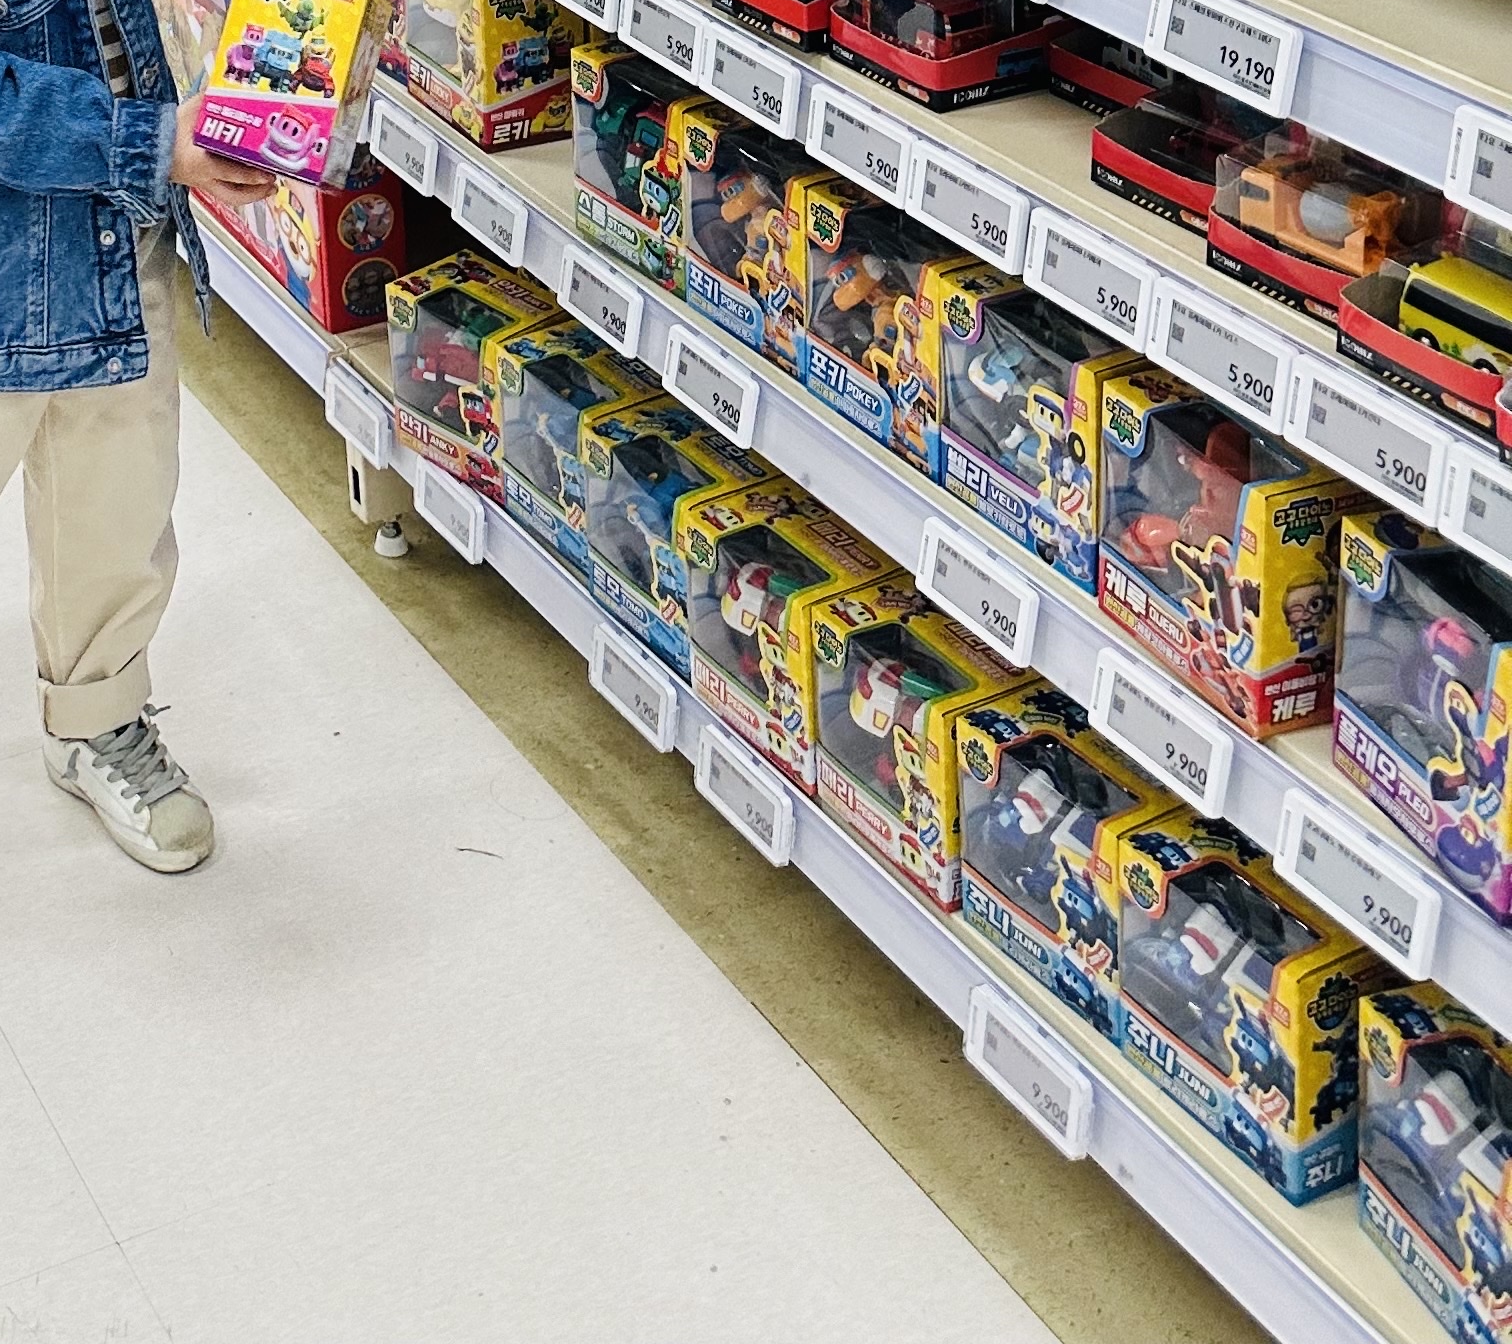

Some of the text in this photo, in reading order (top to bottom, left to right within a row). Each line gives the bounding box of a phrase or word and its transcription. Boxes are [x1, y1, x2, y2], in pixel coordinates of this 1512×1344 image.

[667, 34, 693, 62] 5,900
[1220, 45, 1275, 86] 19,190
[752, 84, 783, 115] 5,900
[492, 119, 530, 144] 로키
[865, 151, 899, 184] 5,900
[491, 218, 513, 246] 9,900
[606, 219, 636, 243] STORM
[971, 211, 1008, 248] 5,900
[690, 263, 721, 305] 포키
[601, 305, 627, 336] 9,900
[721, 291, 751, 321] POKEY
[1096, 285, 1138, 324] 5,900
[811, 346, 846, 394] 포키
[1228, 363, 1275, 405] 5,900
[713, 391, 742, 424] 9,900
[846, 381, 881, 413] POKEY
[399, 411, 429, 445] 안키
[429, 435, 458, 457] ANKY
[1376, 448, 1428, 494] 5,900
[990, 486, 1019, 516] VELI
[1274, 499, 1335, 528] 고고다이노
[1104, 562, 1150, 614] 케루
[981, 599, 1018, 640] 9,900
[1149, 606, 1186, 646] QUERU
[1271, 695, 1317, 722] 케루
[1165, 741, 1209, 787] 9,900
[1337, 716, 1399, 794] 플레오
[1399, 778, 1432, 821] PLEO
[745, 801, 775, 841] 9,900
[855, 800, 891, 836] PERRY
[1362, 893, 1414, 947] 9,900
[1011, 927, 1043, 963] JUNI
[1177, 1064, 1212, 1101] JUNI
[1031, 1080, 1070, 1127] 9,900
